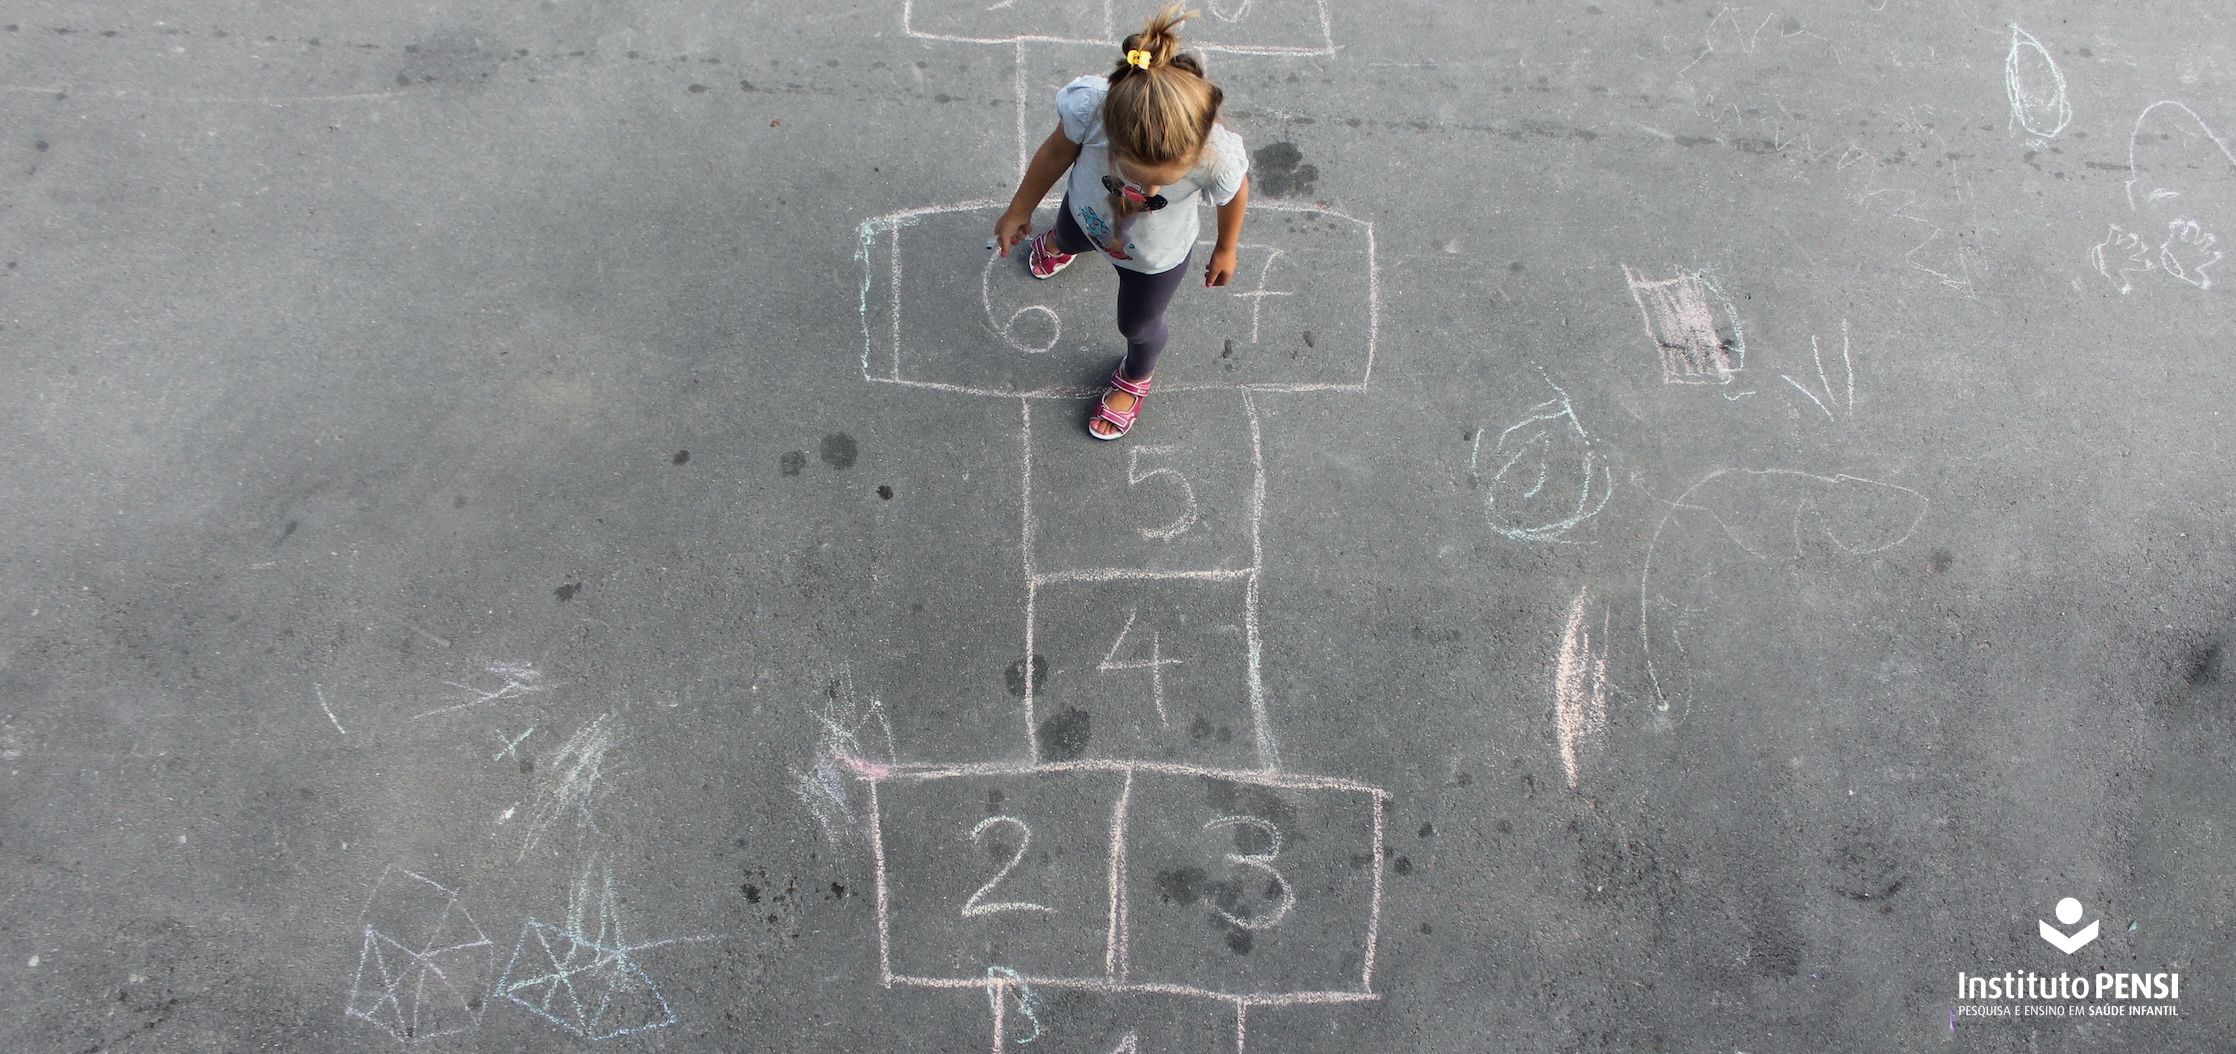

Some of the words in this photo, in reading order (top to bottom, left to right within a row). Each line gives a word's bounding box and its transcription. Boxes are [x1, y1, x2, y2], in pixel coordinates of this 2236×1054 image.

[982, 245, 1062, 353] 6
[1197, 240, 1294, 344] 7
[1127, 444, 1198, 541] 5
[1096, 607, 1184, 729] 4
[960, 813, 1058, 918] 2
[1203, 813, 1296, 931] 3
